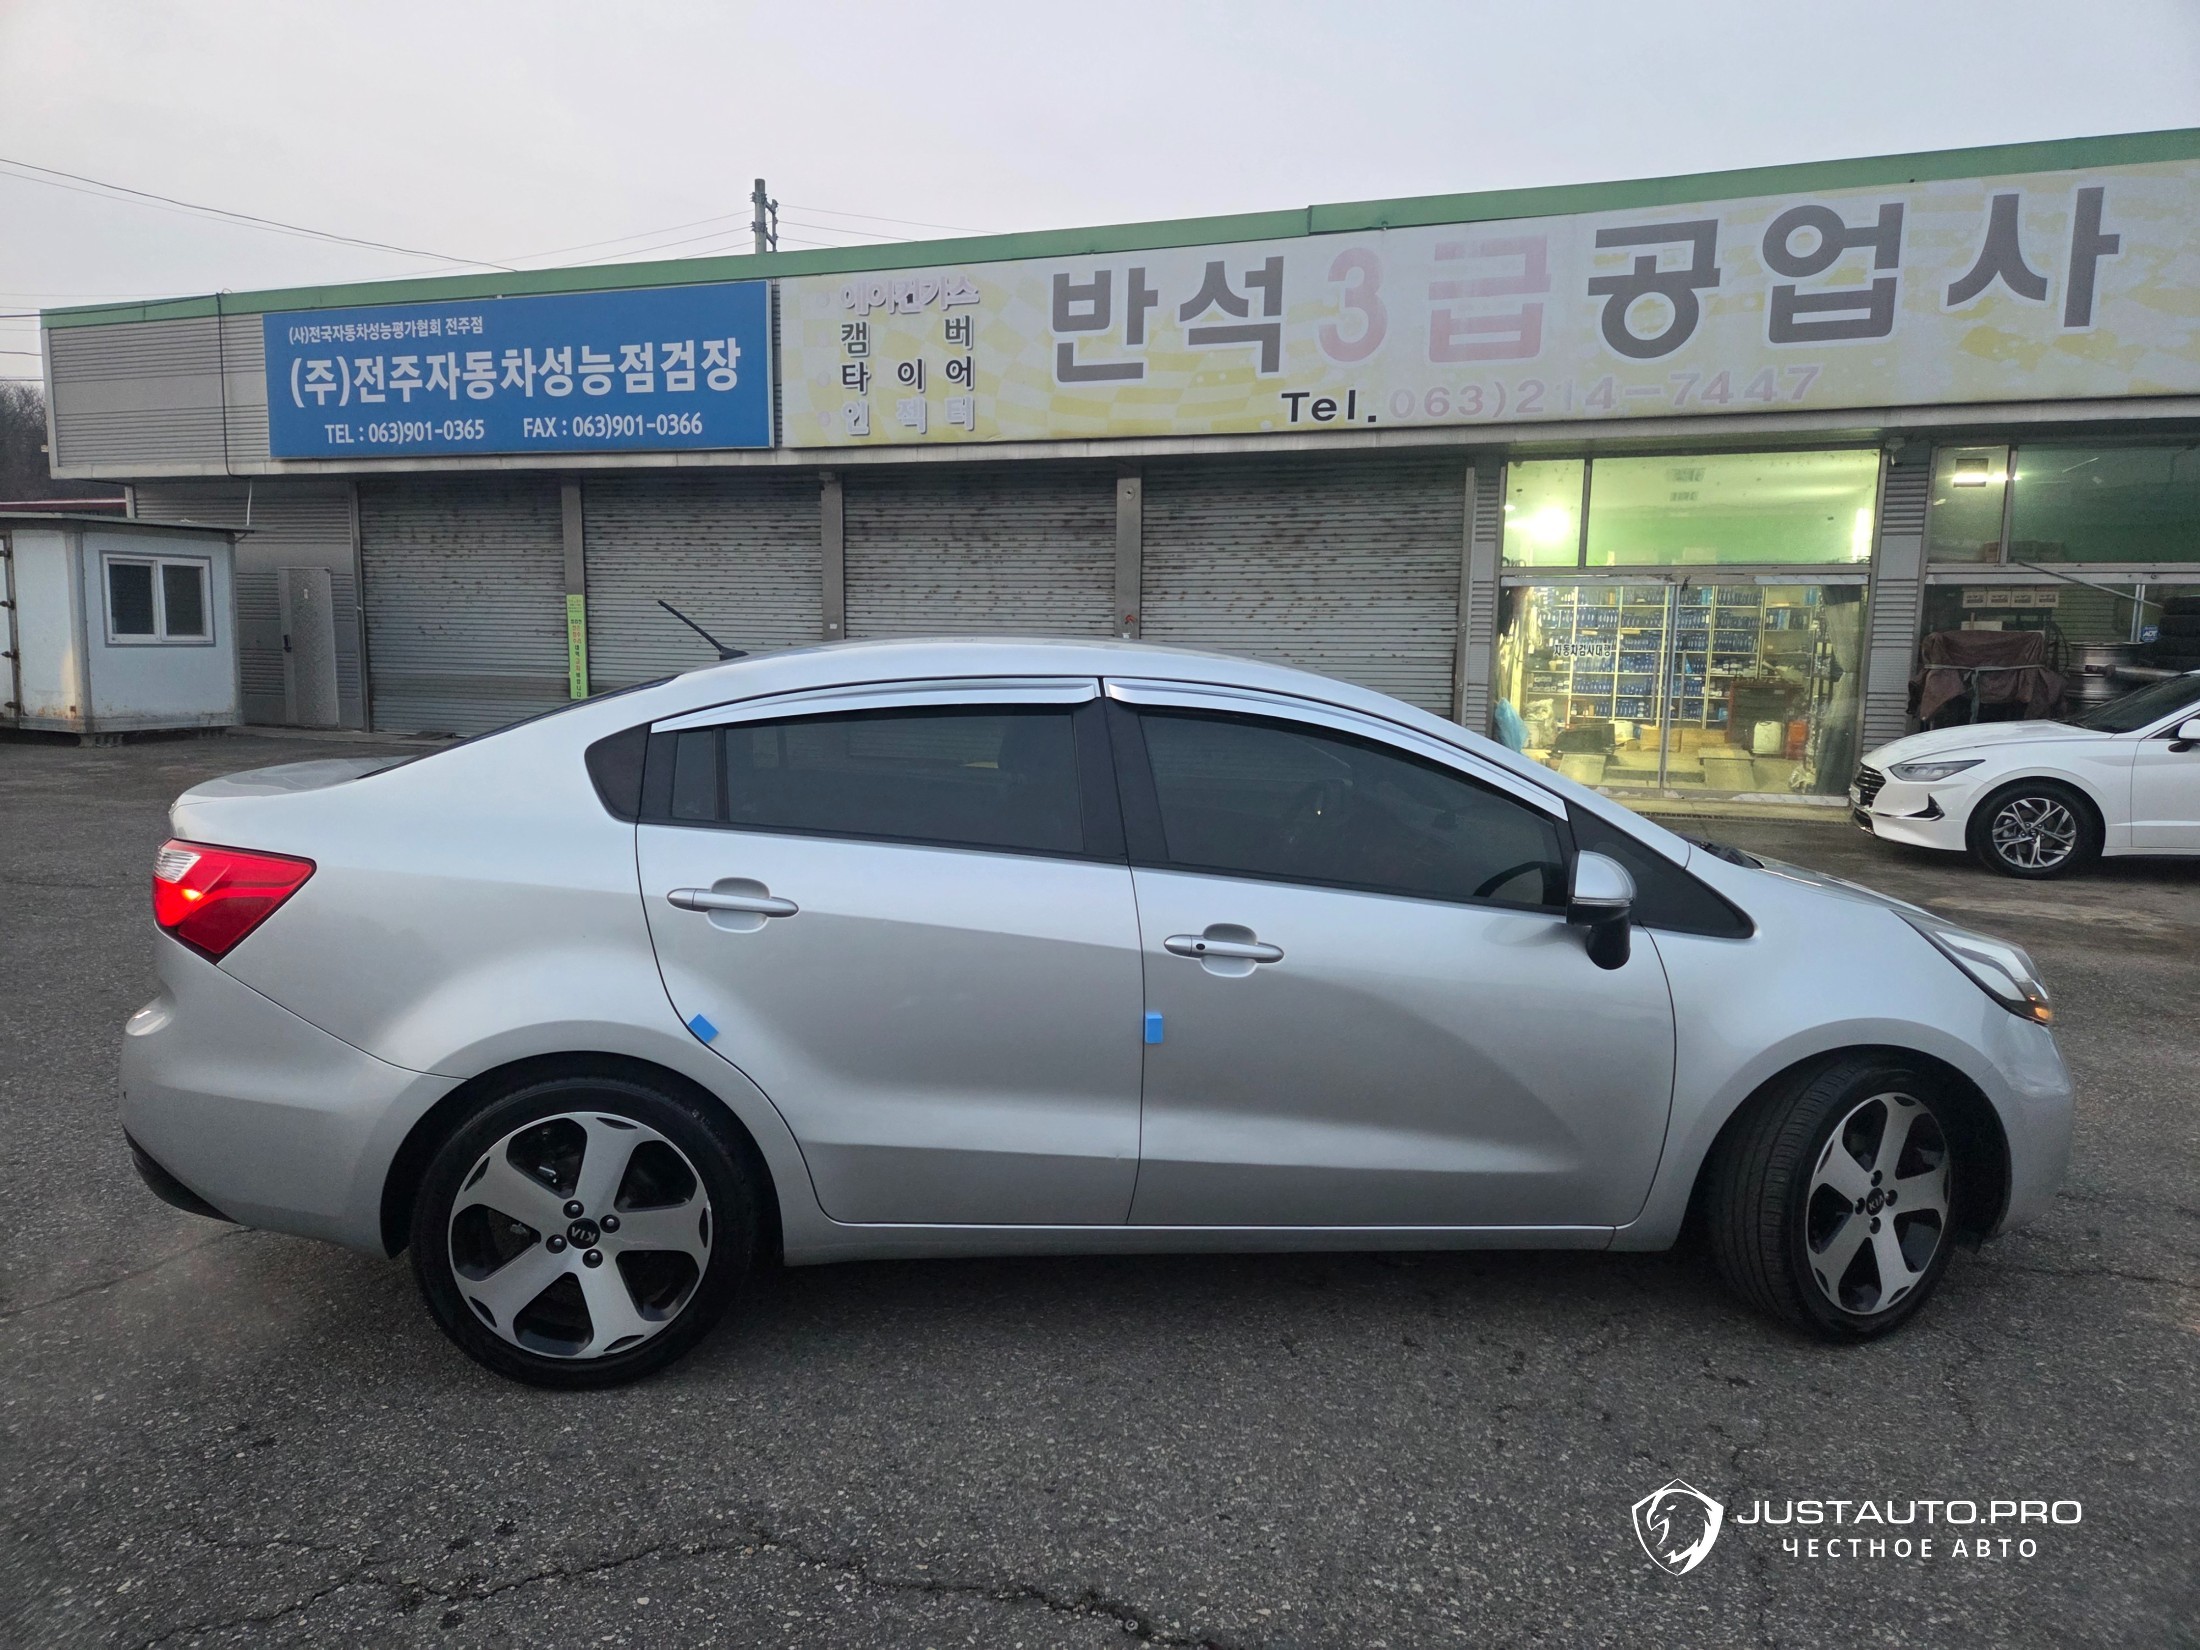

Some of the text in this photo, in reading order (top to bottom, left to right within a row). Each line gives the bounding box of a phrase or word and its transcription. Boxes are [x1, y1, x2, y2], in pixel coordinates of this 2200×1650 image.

[1052, 186, 2121, 383] 반석 3급 공업사
[289, 316, 484, 345] (사)전국자동차성능평가협회 전주점
[291, 337, 742, 408] (주)전주자동차성능점검장
[1281, 389, 1377, 423] Tel.
[368, 418, 485, 445] 063)901-0365
[572, 412, 703, 439] 063)901-0366
[1868, 1194, 1884, 1211] KIA
[571, 1226, 597, 1243] KIA
